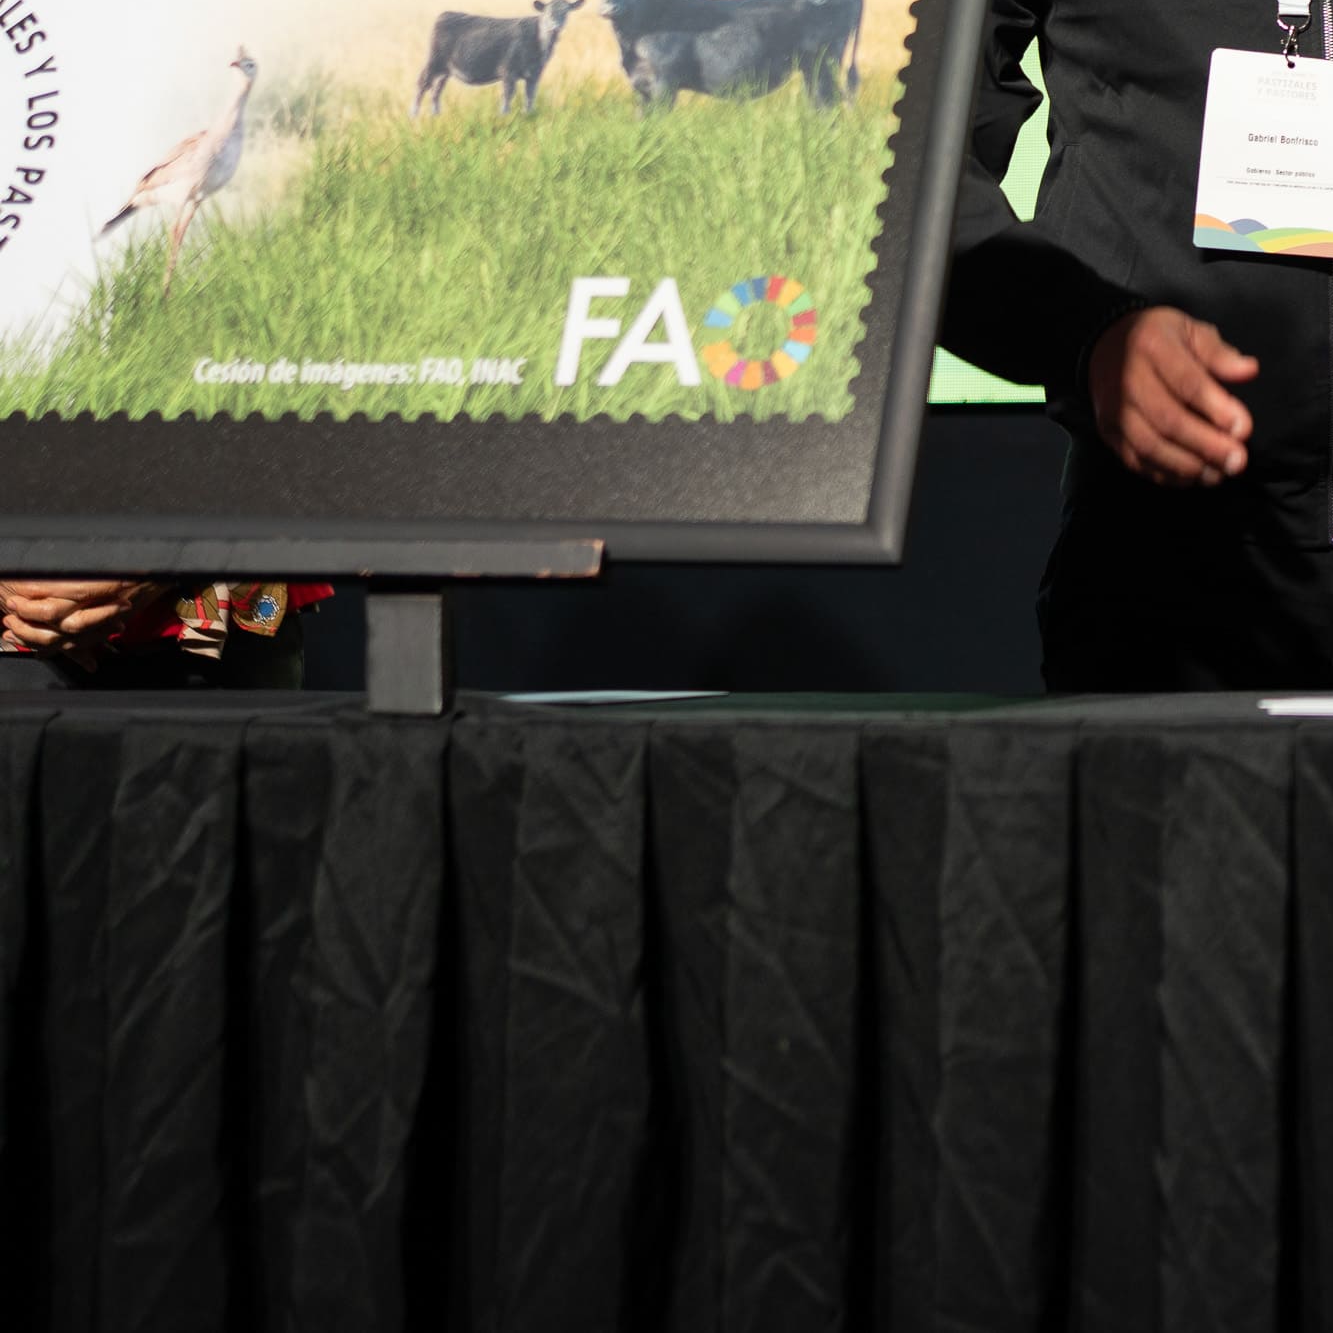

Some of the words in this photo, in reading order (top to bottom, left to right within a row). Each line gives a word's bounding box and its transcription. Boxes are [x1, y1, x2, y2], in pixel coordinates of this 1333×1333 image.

[23, 55, 57, 78] Y
[22, 90, 60, 151] LOS
[1248, 133, 1278, 144] Gabriel
[0, 166, 46, 252] PAS
[192, 357, 266, 384] Cesión
[268, 357, 298, 384] de
[300, 356, 414, 392] imágenes:
[469, 358, 527, 386] INAC
